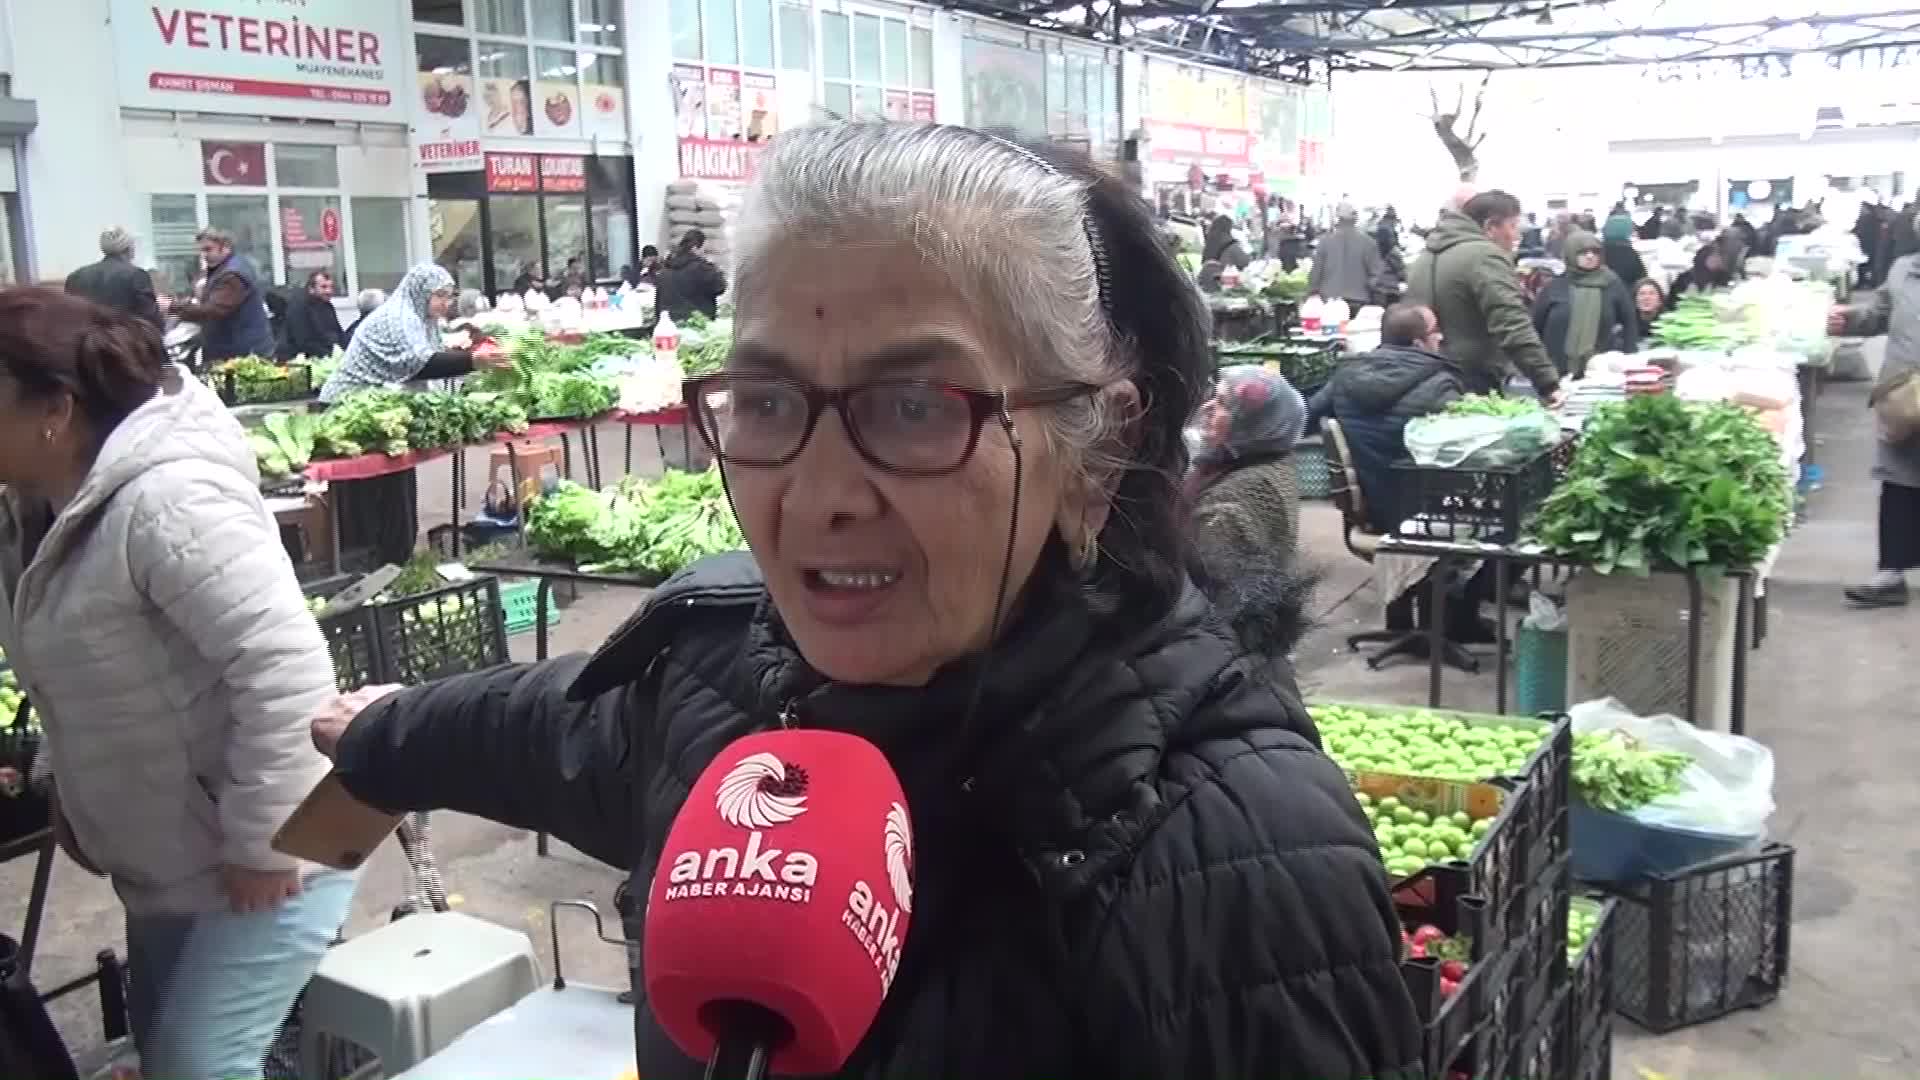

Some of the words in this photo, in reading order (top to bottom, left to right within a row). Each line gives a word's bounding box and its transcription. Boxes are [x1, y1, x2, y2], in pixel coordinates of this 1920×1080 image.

[152, 6, 381, 65] VETERİNER
[418, 141, 481, 160] VETERİNER
[669, 831, 818, 887] anka
[665, 882, 727, 901] HABER
[732, 881, 811, 903] AJANSI
